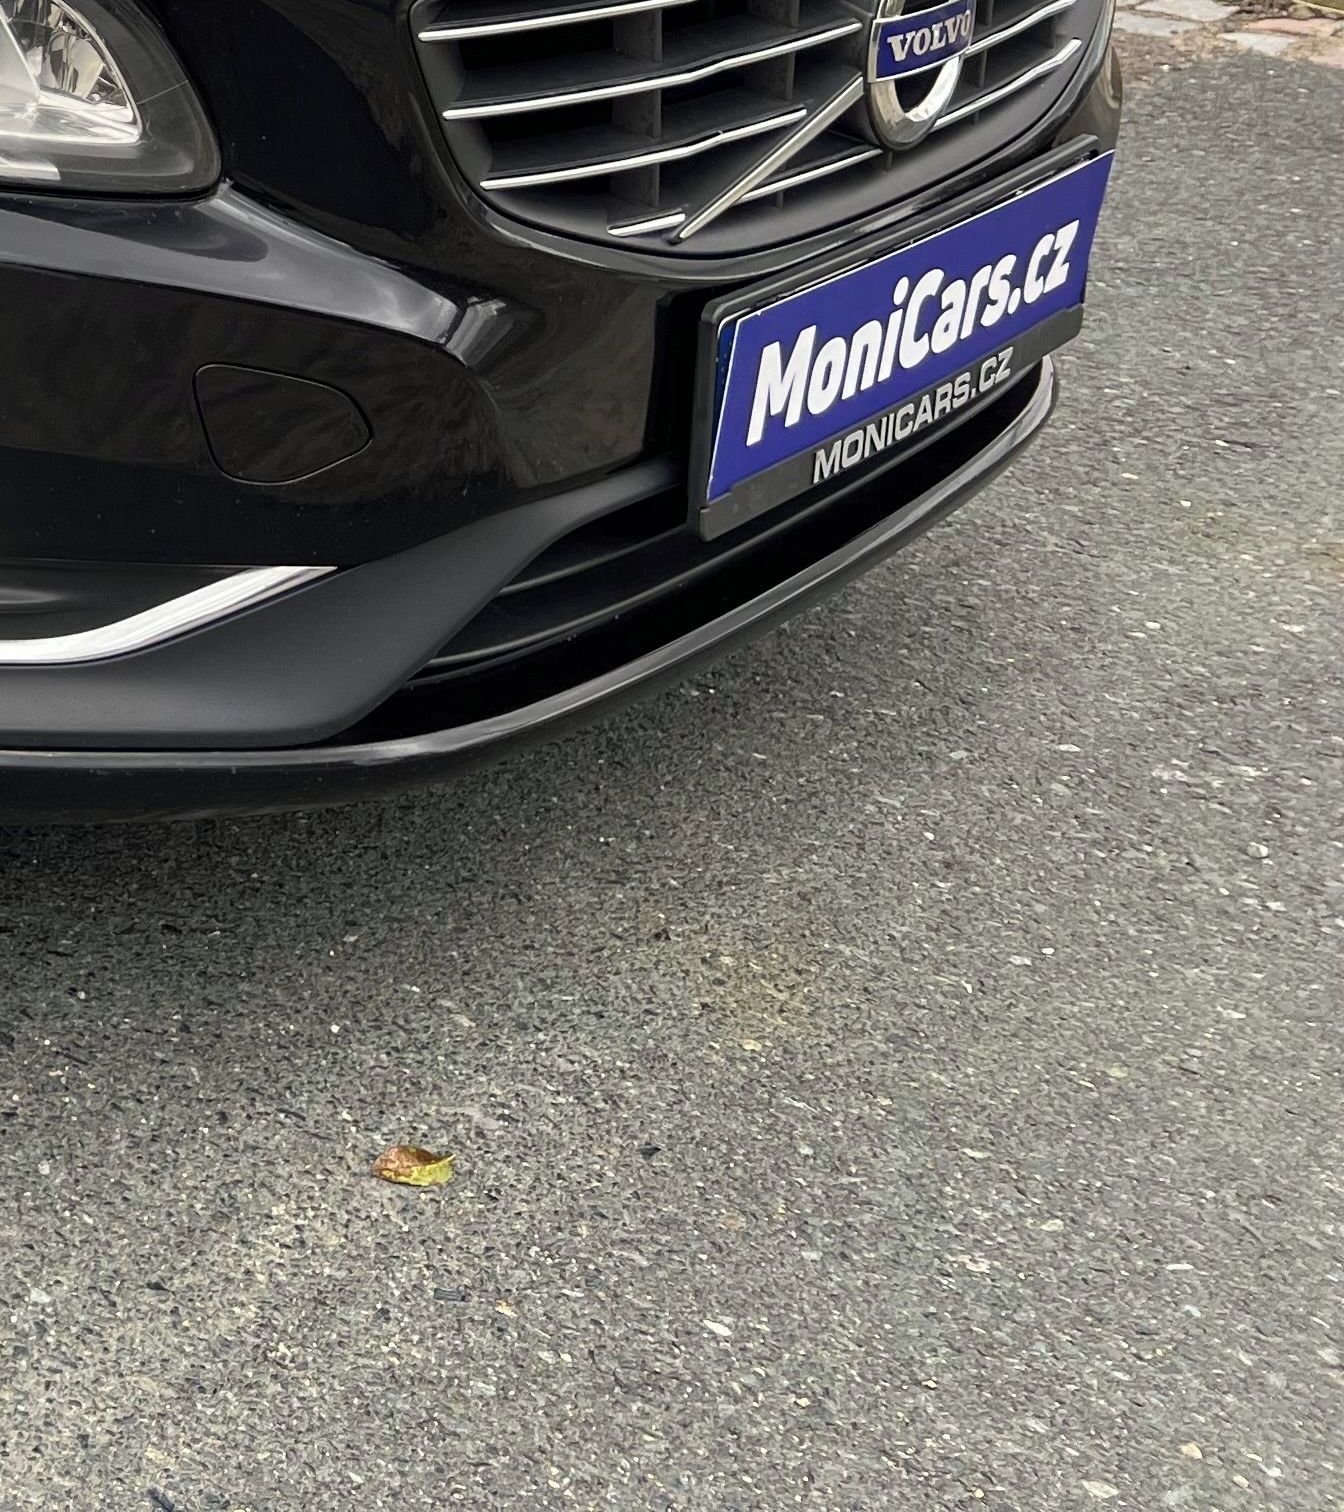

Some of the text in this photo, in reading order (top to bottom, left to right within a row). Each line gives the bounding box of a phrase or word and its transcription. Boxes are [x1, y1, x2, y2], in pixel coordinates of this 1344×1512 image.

[886, 8, 972, 62] VOLVO
[745, 218, 1081, 447] MoniCars.cz
[811, 345, 1014, 485] MONICARS.CZ
